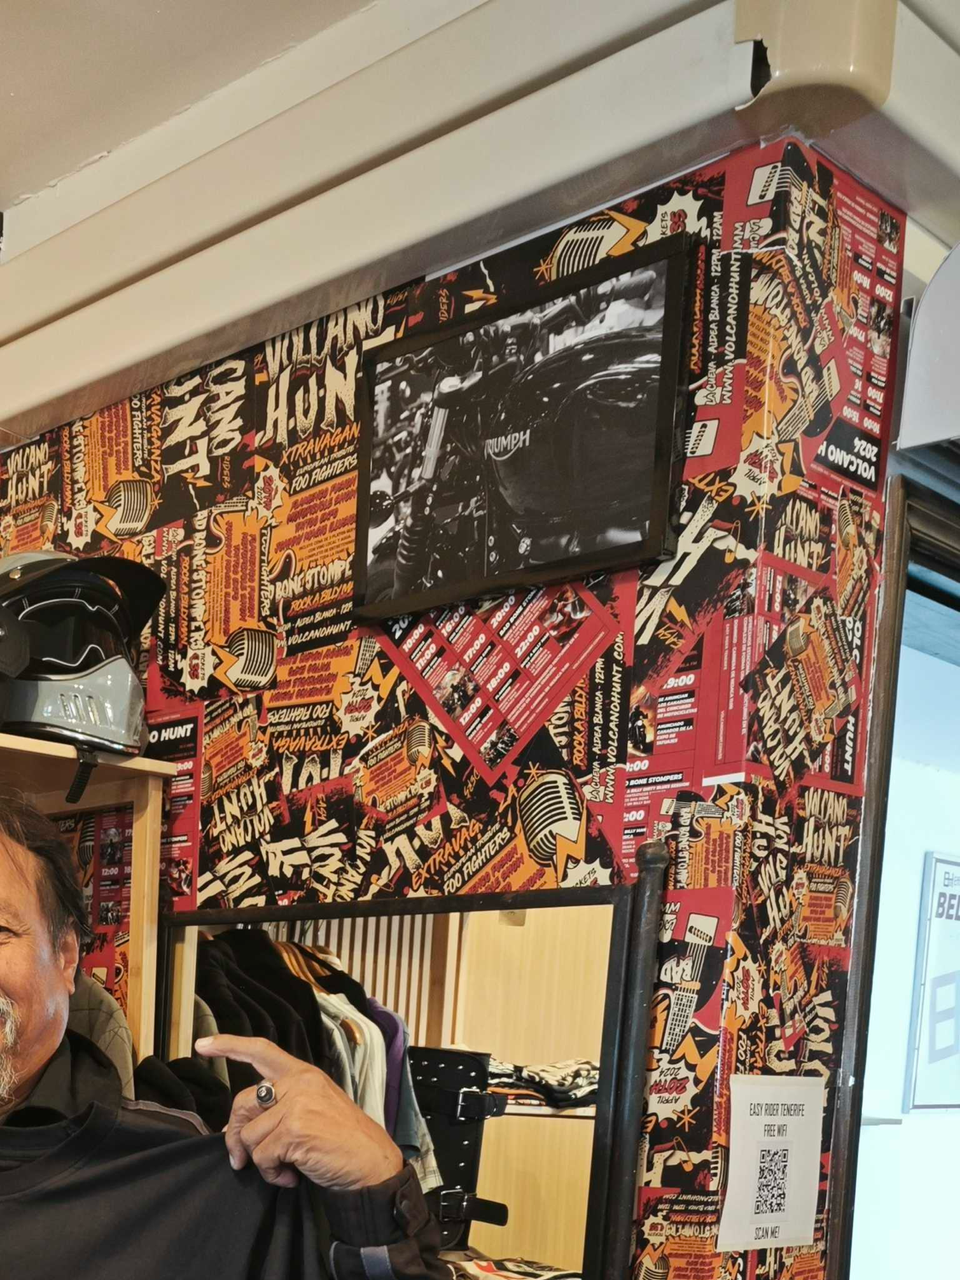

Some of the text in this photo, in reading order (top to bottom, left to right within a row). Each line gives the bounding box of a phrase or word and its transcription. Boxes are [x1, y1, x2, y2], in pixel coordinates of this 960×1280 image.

[852, 270, 870, 289] 18:00
[875, 284, 892, 301] 12:00
[708, 212, 723, 391] CUEVA ALDEA BLANCA 12PM 12AM
[785, 320, 808, 372] BONE
[867, 387, 883, 402] 11:00
[132, 411, 143, 467] FIGHTERS
[864, 417, 880, 434] 10:00
[8, 443, 49, 476] VOLCANO
[828, 444, 876, 482] VOLCANO
[854, 437, 878, 462] 2024
[71, 431, 88, 511] STOMPERS
[291, 453, 358, 494] FOO FIGHTERS
[276, 575, 303, 599] BONE
[190, 567, 207, 649] STOMPERS
[441, 606, 465, 637] 16:00
[490, 595, 515, 629] 20:00
[402, 623, 425, 653] 10:00
[463, 633, 486, 663] 17:00
[515, 625, 540, 659] 22:00
[415, 644, 436, 670] 11:00
[486, 662, 510, 693] 18:00
[267, 703, 333, 723] FOO FIGHTERS
[459, 697, 482, 726] 12:00
[591, 658, 605, 788] CUEVA ALDEA BLANCA 12PM
[160, 724, 194, 742] HUNT
[843, 715, 856, 776] HUNT
[572, 736, 586, 767] ROCK
[629, 774, 683, 786] BONE STOMPERS
[804, 787, 848, 823] VOLCANO
[102, 868, 119, 876] 12:00
[443, 828, 511, 895] FOO FIGHTERS
[650, 1076, 689, 1095] 20TH
[657, 1096, 681, 1105] APRIL
[749, 1103, 805, 1117] EASY RIDER TENERIFE
[763, 1124, 787, 1137] FREE WIFI
[754, 1226, 780, 1241] SCAN ME!
